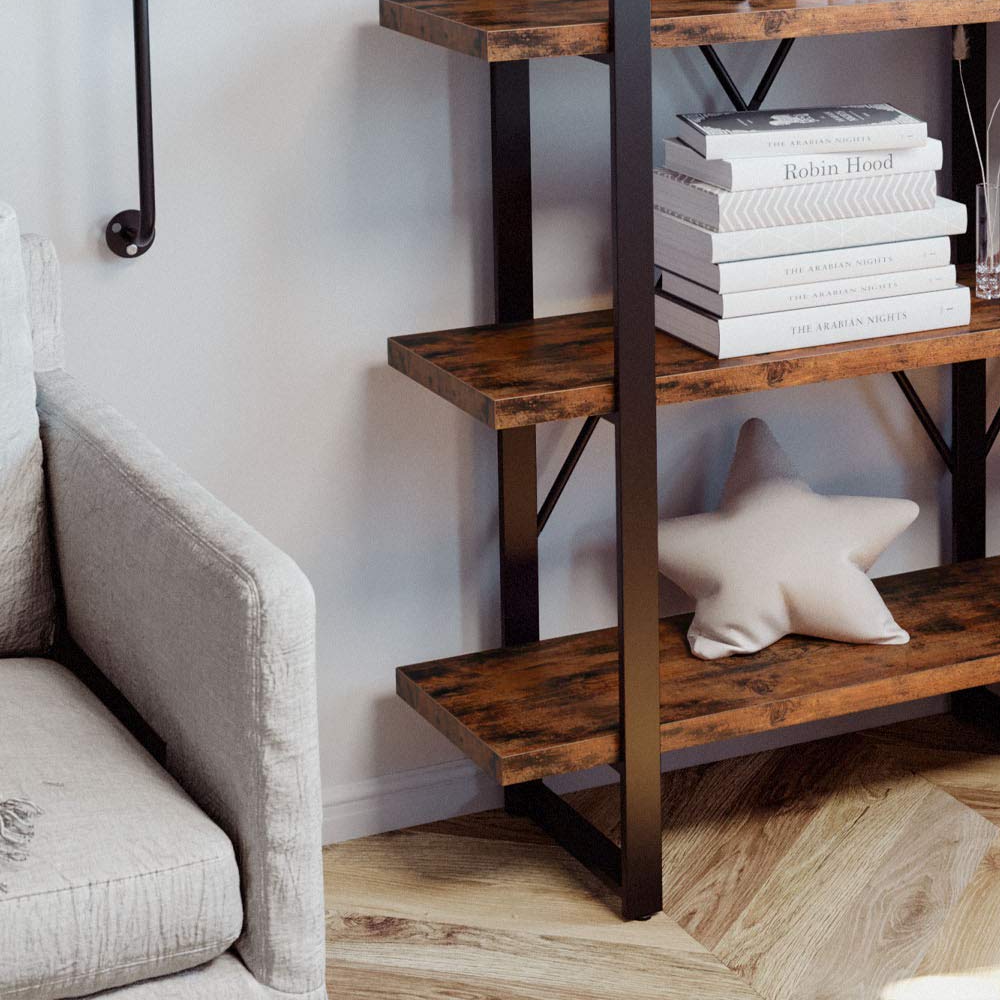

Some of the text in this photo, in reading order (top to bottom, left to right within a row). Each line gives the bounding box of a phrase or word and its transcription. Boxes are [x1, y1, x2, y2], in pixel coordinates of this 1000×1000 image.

[784, 152, 894, 180] Robin Hood
[791, 311, 908, 336] THE ARABIAN NIGHTS
